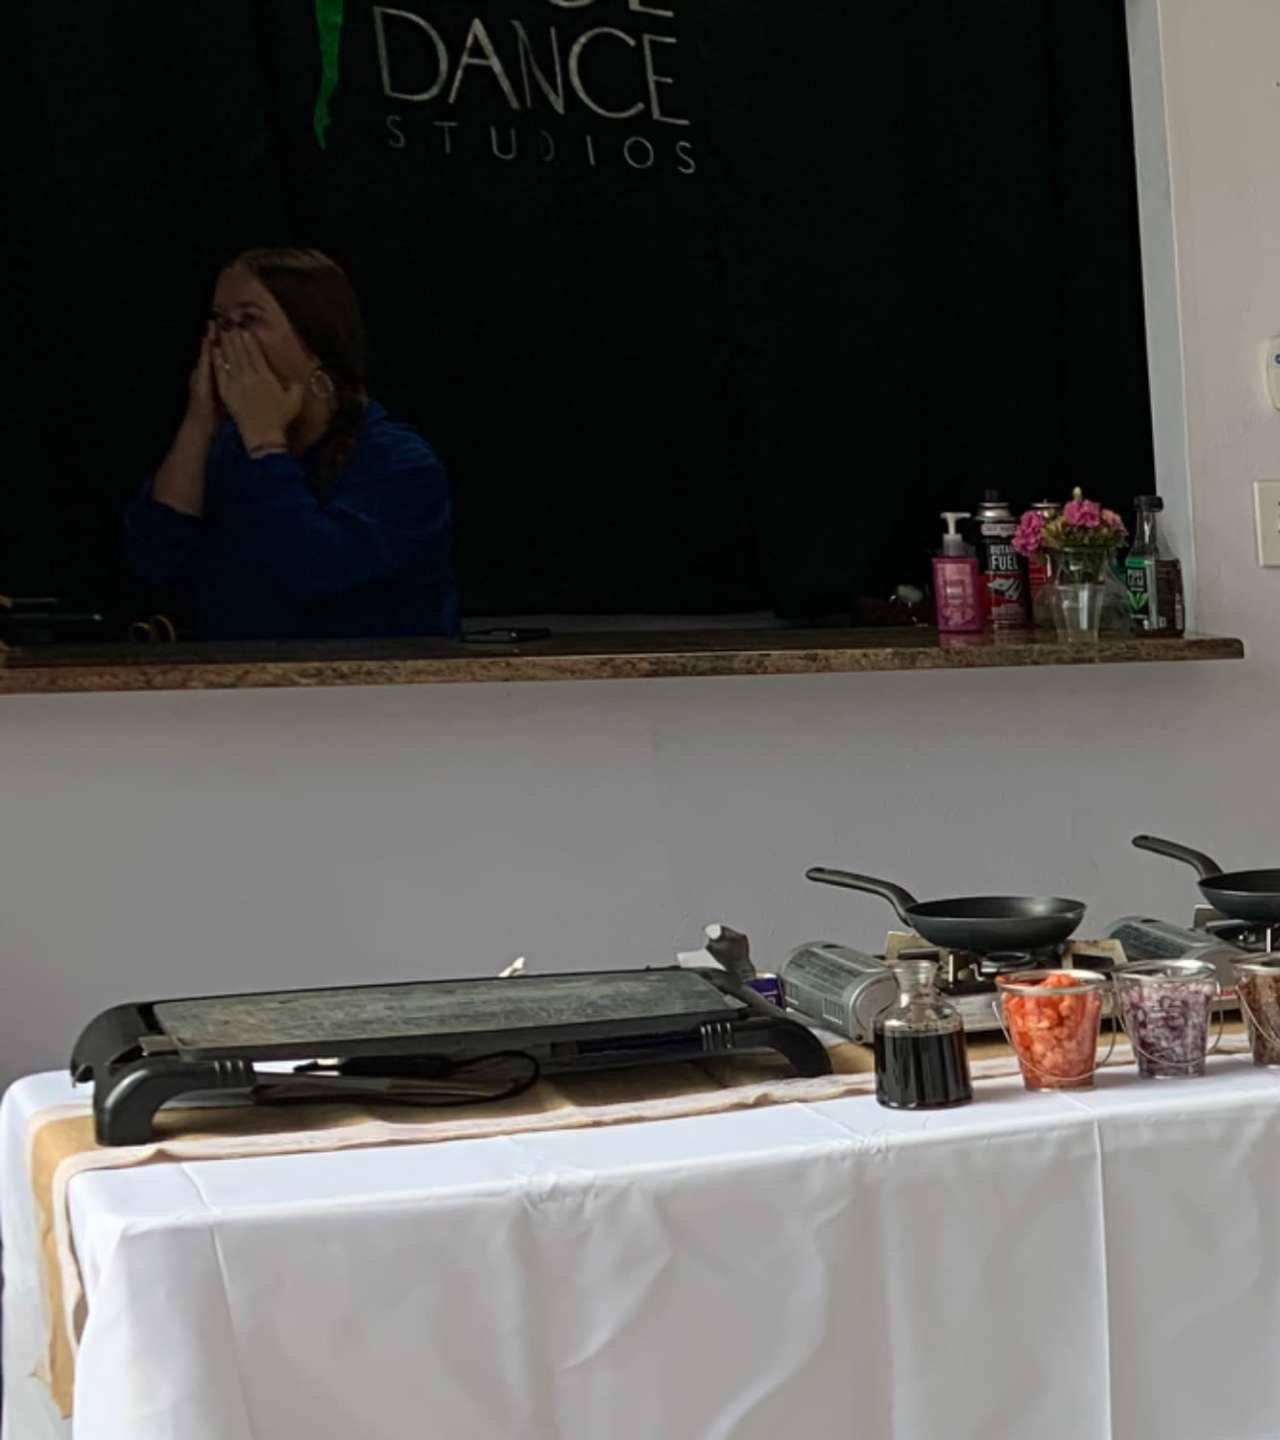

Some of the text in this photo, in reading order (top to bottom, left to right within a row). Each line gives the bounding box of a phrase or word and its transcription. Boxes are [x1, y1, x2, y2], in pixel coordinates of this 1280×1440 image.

[374, 5, 691, 126] DANCE
[385, 114, 696, 174] STUDIOS
[991, 554, 1019, 570] FUEL
